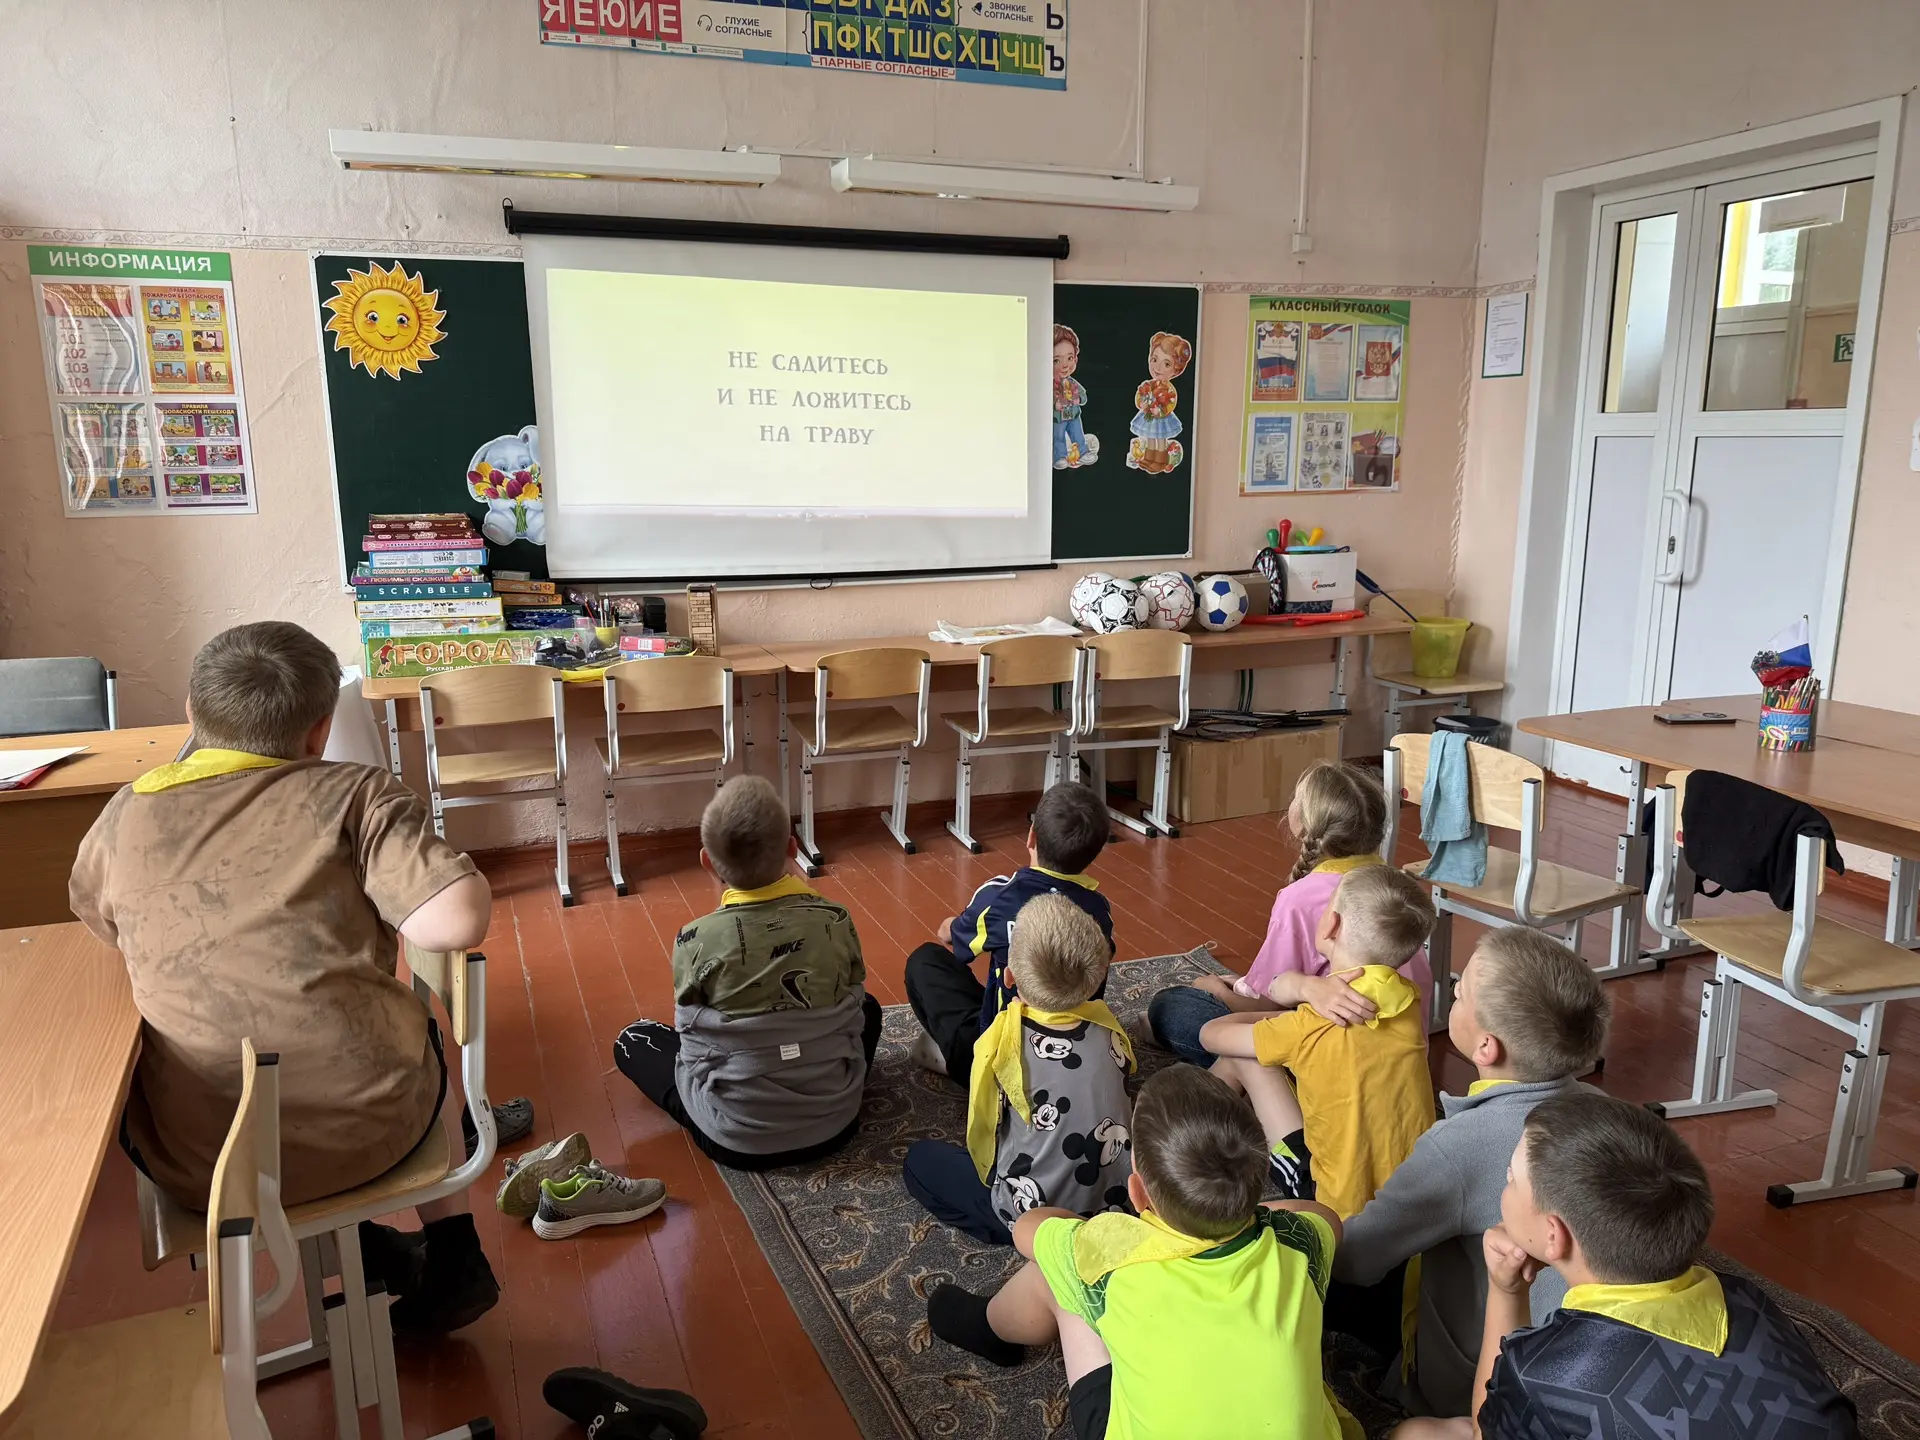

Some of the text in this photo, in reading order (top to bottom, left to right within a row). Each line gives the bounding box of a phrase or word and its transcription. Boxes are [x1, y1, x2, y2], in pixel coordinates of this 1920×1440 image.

[989, 2, 1027, 13] ЗВОНКИЕ
[725, 16, 760, 27] ГЛУХИЕ
[984, 10, 1034, 22] СОГЛАСНЫЕ
[715, 25, 773, 38] СОГЛАСНЫЕ
[819, 56, 950, 78] ПАРНЫЕ СОГЛАСНЫЕ
[48, 250, 212, 274] ИНФОРМАЦИЯ
[1269, 299, 1391, 314] КЛАССНЫЙ УГОЛОК
[59, 319, 83, 330] 112
[60, 333, 85, 345] 101
[63, 348, 87, 359] 102
[65, 362, 89, 374] 103
[728, 350, 889, 376] НЕ САДИТЕСЬ
[67, 377, 91, 388] 104
[716, 388, 912, 412] И НЕ ЛОЖИТЕСЬ
[759, 425, 875, 445] НА ТРАВУ
[378, 586, 470, 596] SCRABBLE
[1315, 581, 1337, 589] mondi
[769, 937, 806, 960] NIKE
